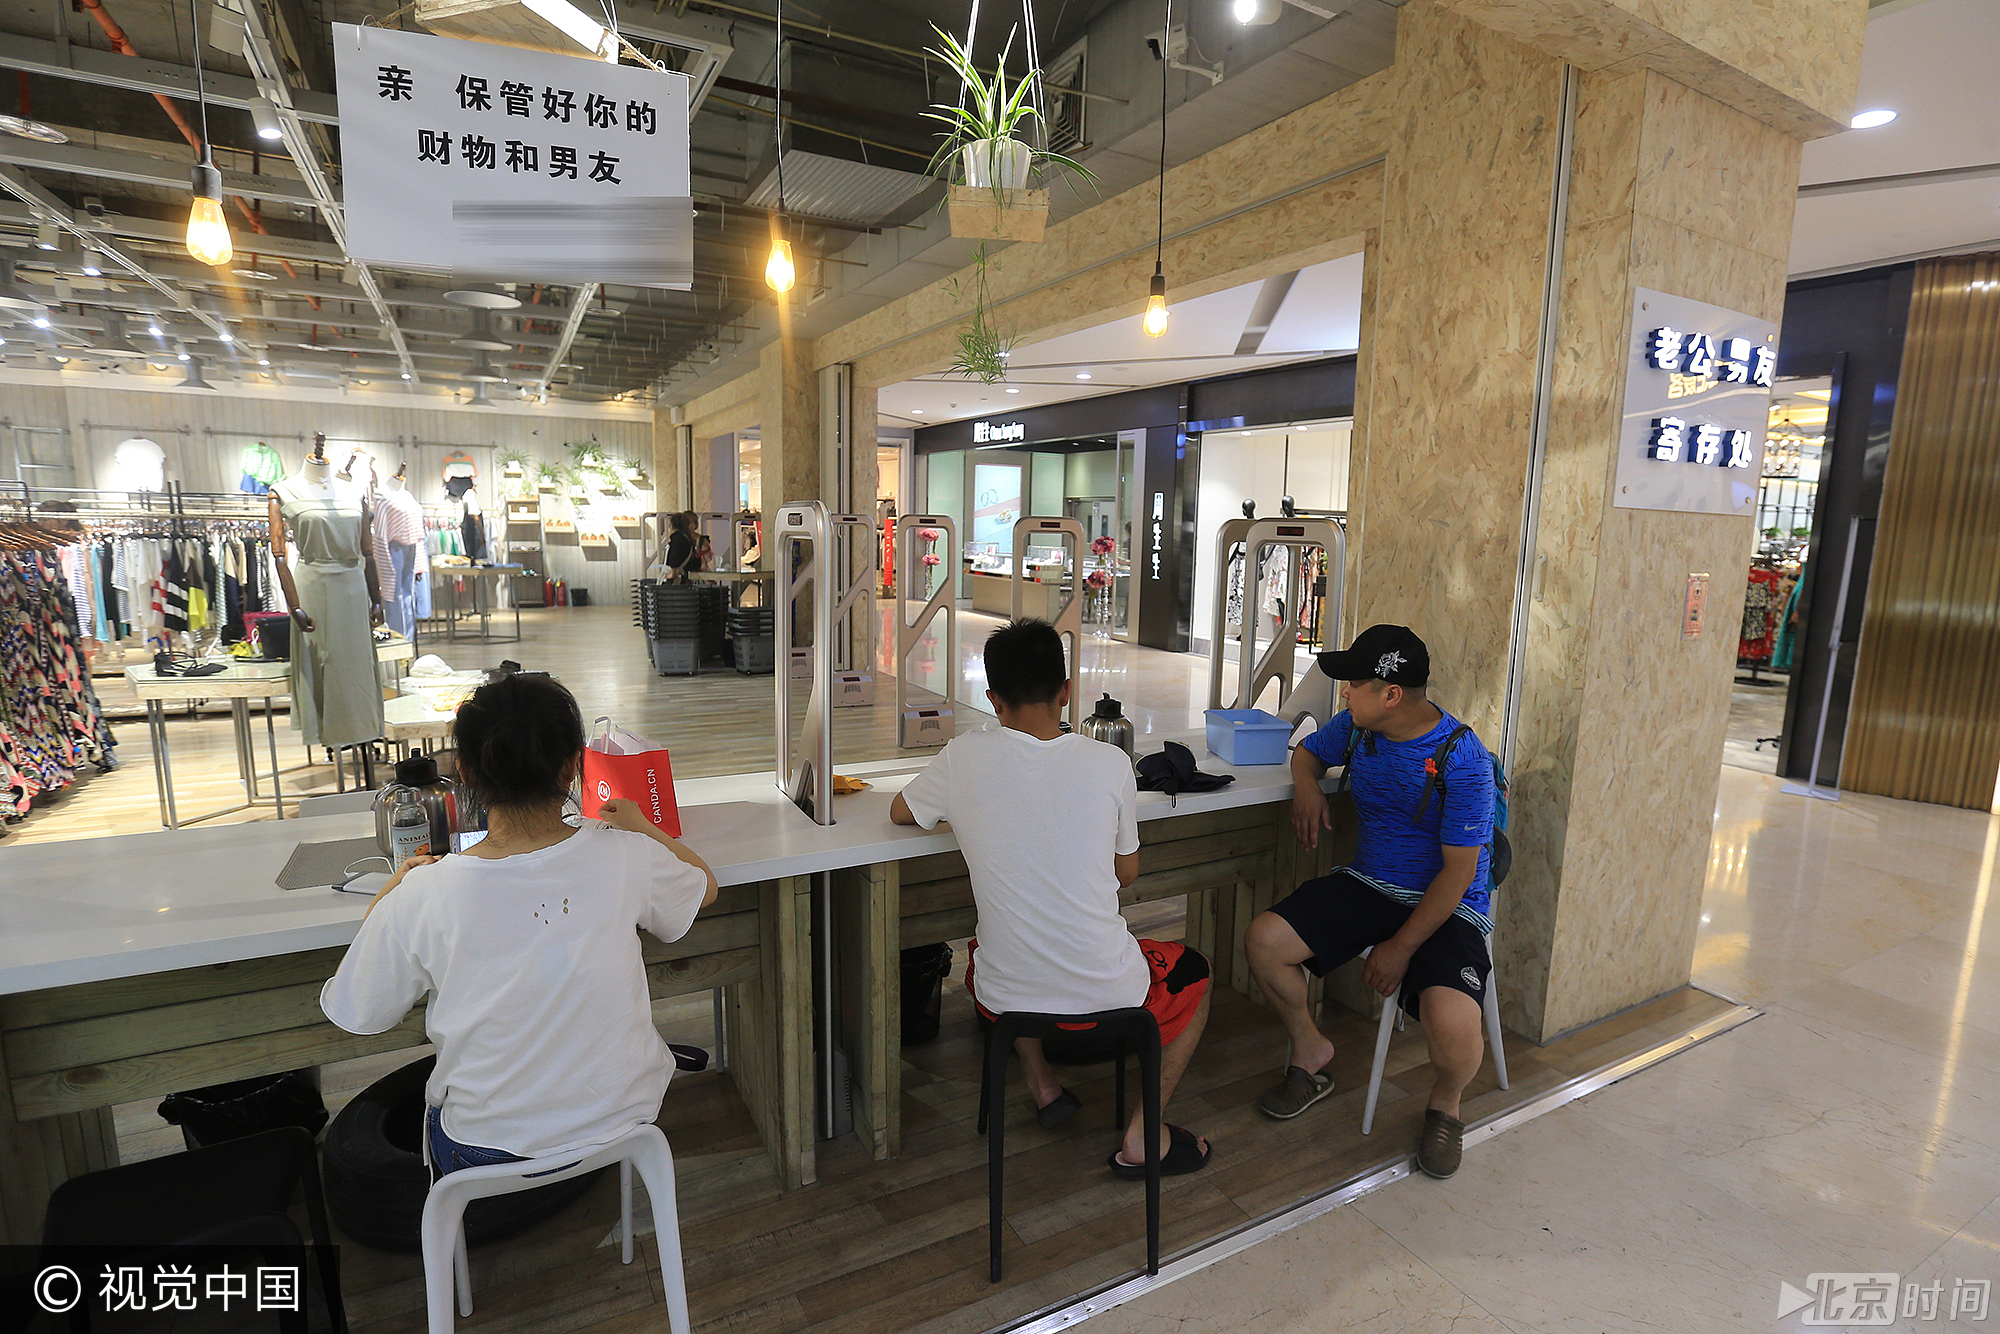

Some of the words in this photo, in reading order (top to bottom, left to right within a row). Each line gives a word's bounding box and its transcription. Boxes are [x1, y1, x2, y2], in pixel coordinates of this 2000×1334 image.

[377, 65, 414, 101] 亲
[454, 74, 658, 135] 保管好你的
[417, 129, 622, 185] 财物和男友
[1651, 326, 1776, 387] 老公男友
[1652, 416, 1753, 468] 寄存处
[646, 768, 662, 824] CANDA.CN
